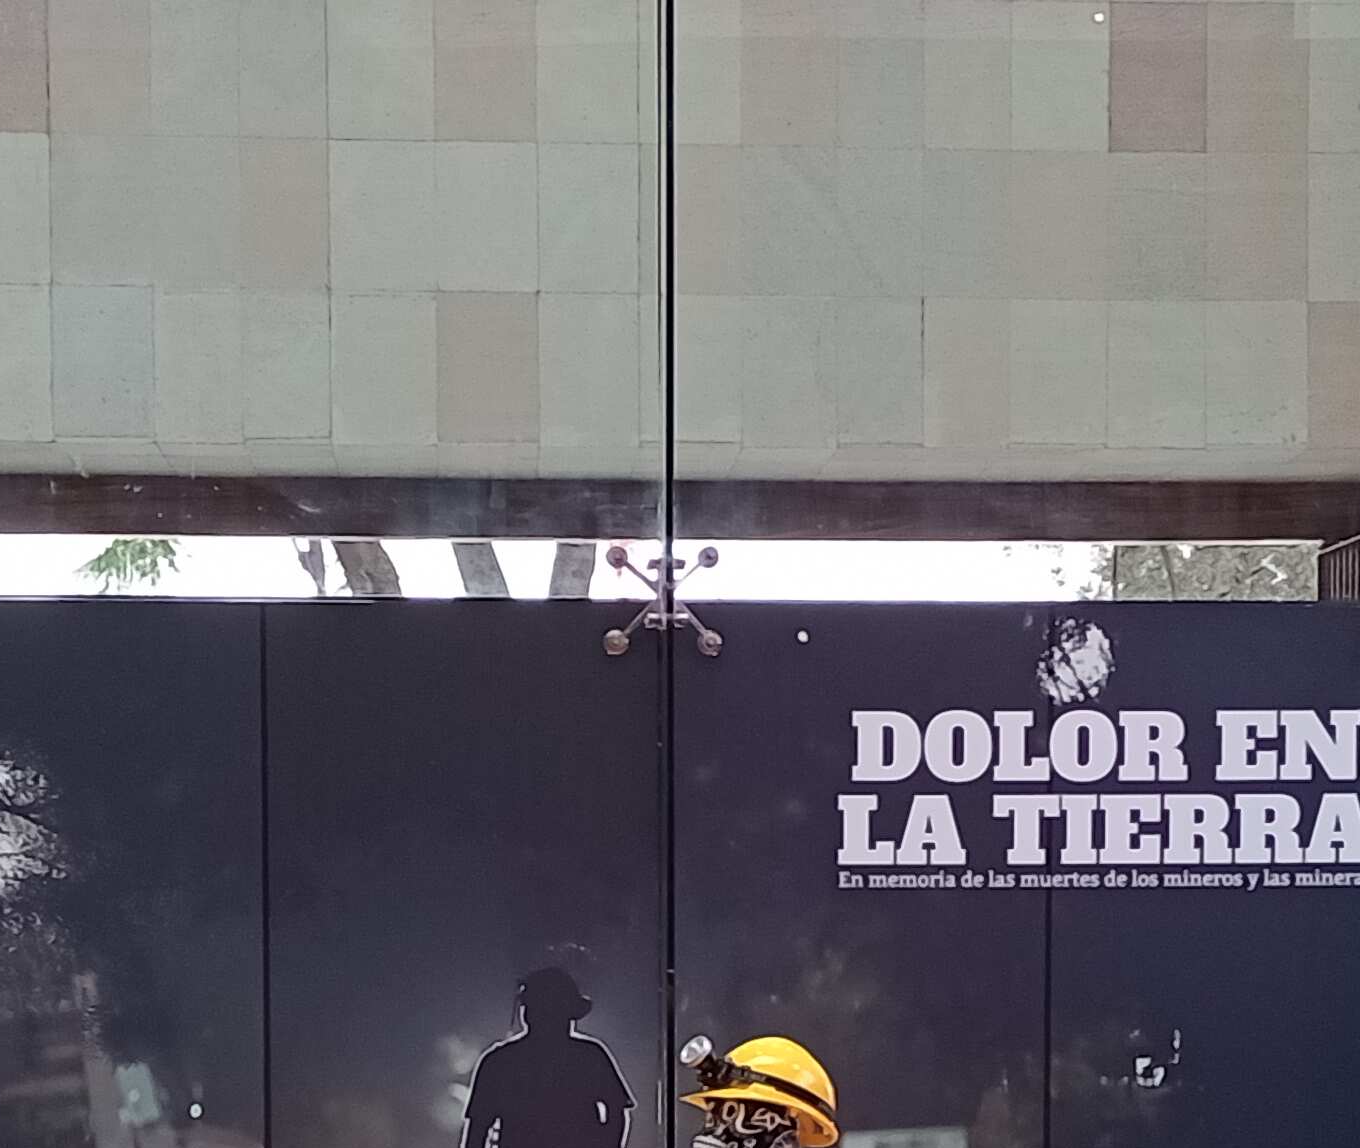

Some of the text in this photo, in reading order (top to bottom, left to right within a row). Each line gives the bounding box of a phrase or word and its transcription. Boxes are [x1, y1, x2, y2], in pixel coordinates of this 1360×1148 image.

[850, 708, 1189, 783] DOLOR
[836, 792, 967, 867] LA
[838, 871, 864, 889] En
[868, 870, 956, 889] memoria
[960, 869, 985, 888] de
[988, 869, 1016, 888] las
[1020, 871, 1100, 888] muertes
[1103, 869, 1128, 888] de
[1131, 869, 1159, 888] los
[1163, 869, 1243, 887] mineros
[1247, 873, 1259, 891] y
[1263, 868, 1291, 887] las
